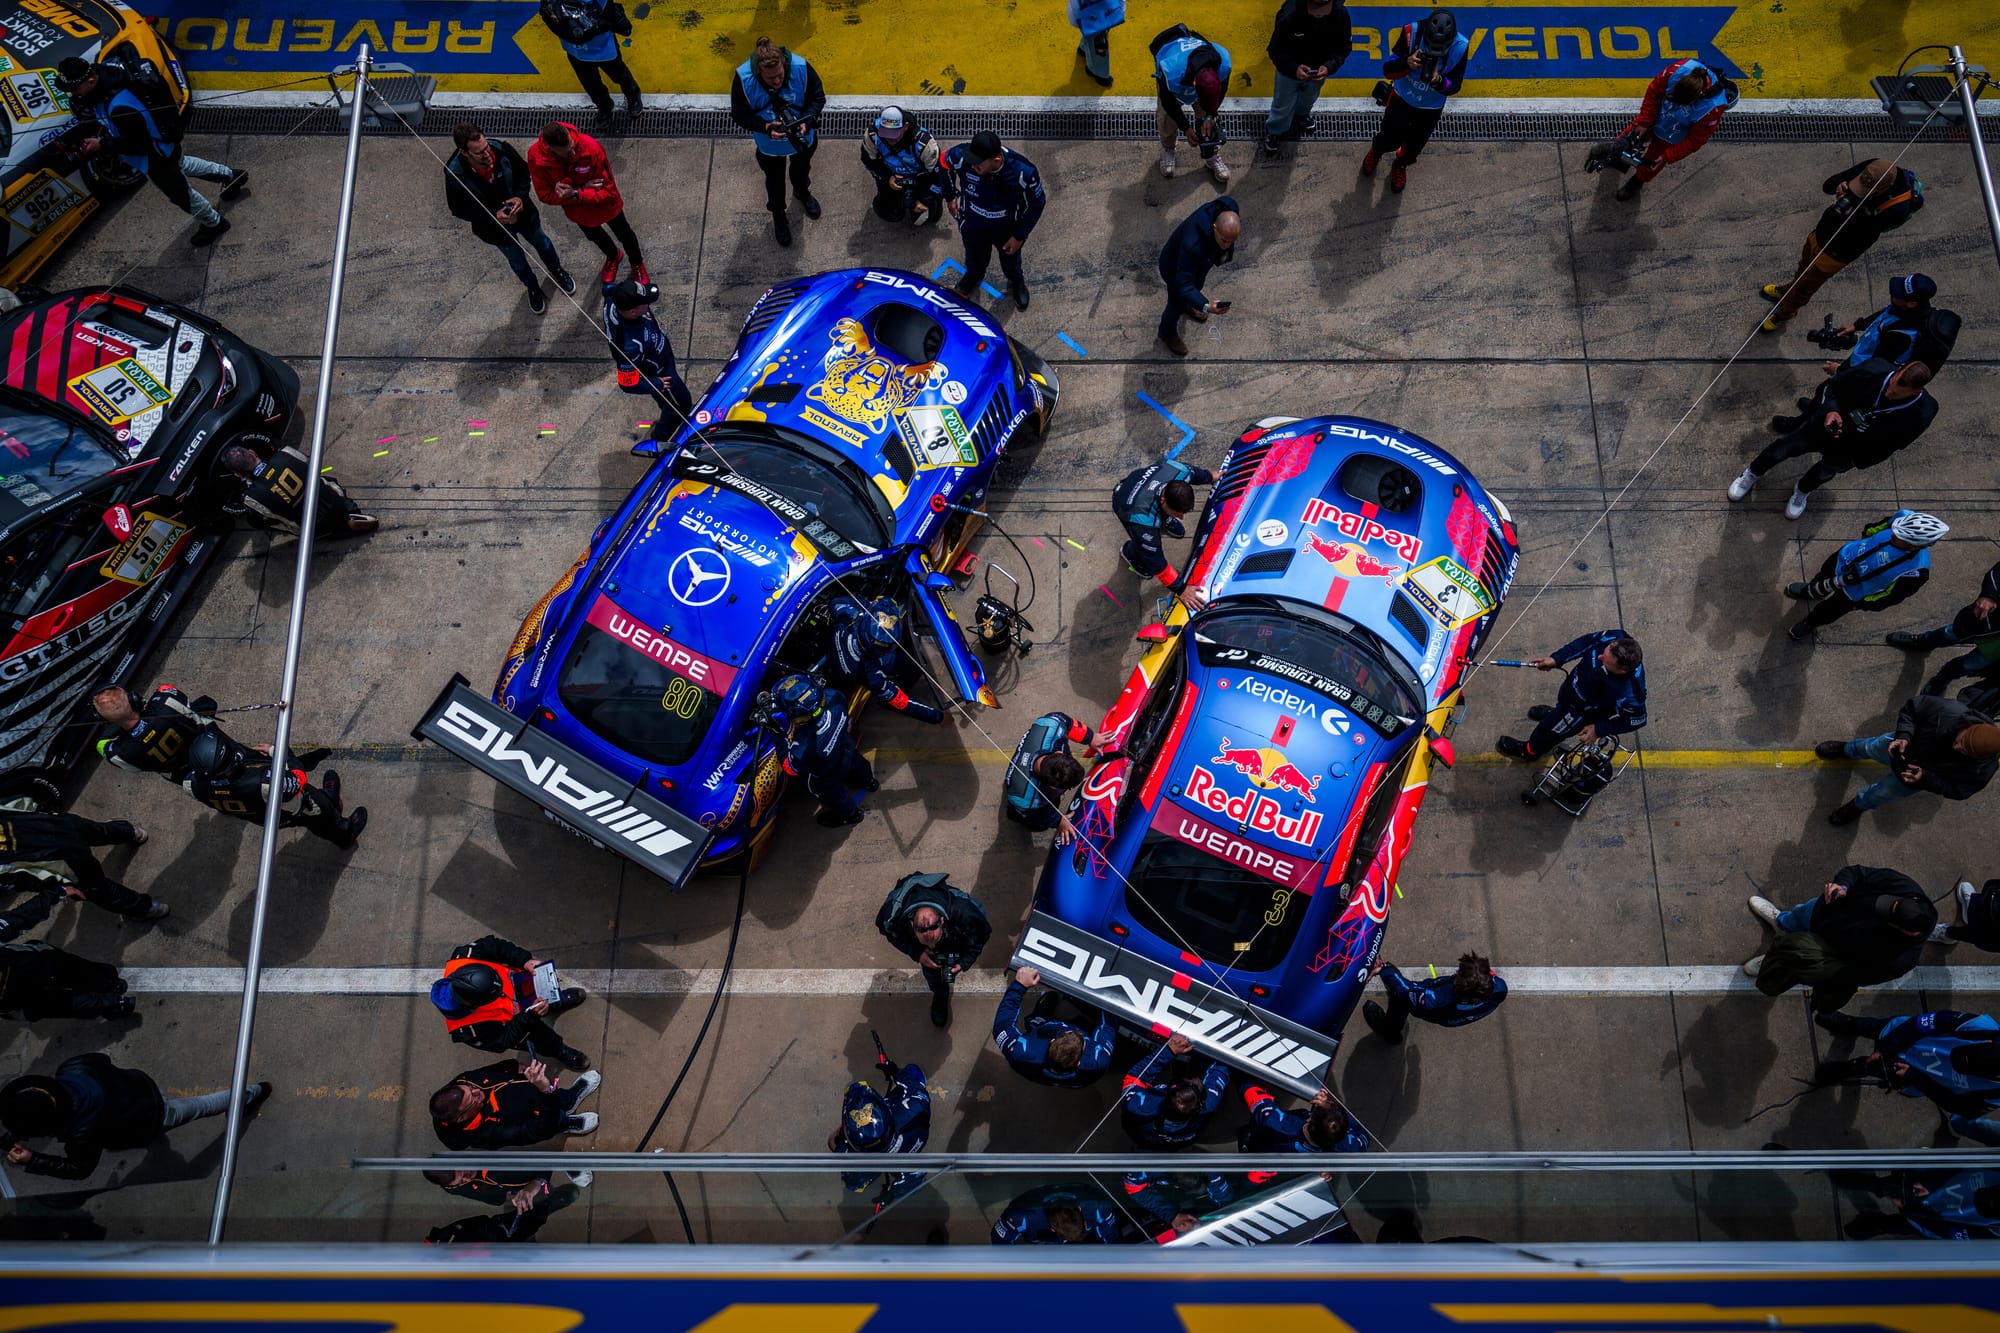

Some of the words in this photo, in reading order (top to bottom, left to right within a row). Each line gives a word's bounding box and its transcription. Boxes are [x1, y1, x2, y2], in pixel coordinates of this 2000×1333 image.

[0, 15, 55, 50] PUNKT
[18, 0, 101, 39] CMS
[3, 31, 41, 57] ROT
[18, 79, 51, 110] 962
[24, 187, 61, 221] 962
[48, 193, 83, 224] DEKRA
[75, 331, 128, 357] FALKEN
[103, 377, 129, 405] 50
[123, 360, 158, 393] DEKRA
[78, 383, 116, 421] RAVENOL
[806, 409, 861, 444] RAVENOL
[900, 411, 927, 465] RAVENOL
[918, 425, 946, 454] 80
[944, 410, 967, 444] DEKRA
[995, 408, 1028, 457] FALKEN
[168, 429, 207, 482] FALKEN
[269, 467, 304, 504] 10
[768, 495, 806, 523] GRAN
[1301, 498, 1363, 538] Bull
[131, 535, 156, 567] 50
[153, 526, 184, 566] DEKRA
[686, 505, 778, 562] MOTORSPORT
[1360, 520, 1421, 564] Red
[1221, 548, 1242, 586] viaplay
[1442, 562, 1481, 597] DEKRA
[1502, 551, 1520, 600] FALKEN
[1406, 582, 1452, 623] RAVENOL
[1438, 584, 1458, 603] 3
[0, 632, 72, 682] GTI
[88, 600, 128, 636] 50
[608, 613, 710, 682] WEMPE
[1426, 627, 1445, 662] viaplay
[660, 675, 703, 721] 80
[1237, 677, 1316, 720] viaplay
[1314, 677, 1353, 702] GRAN
[146, 727, 185, 764] 10
[1185, 769, 1254, 827] Red
[1253, 797, 1324, 848] Bull
[1179, 818, 1295, 882] WEMPE
[1264, 889, 1291, 927] 3
[1366, 927, 1385, 967] viaplay
